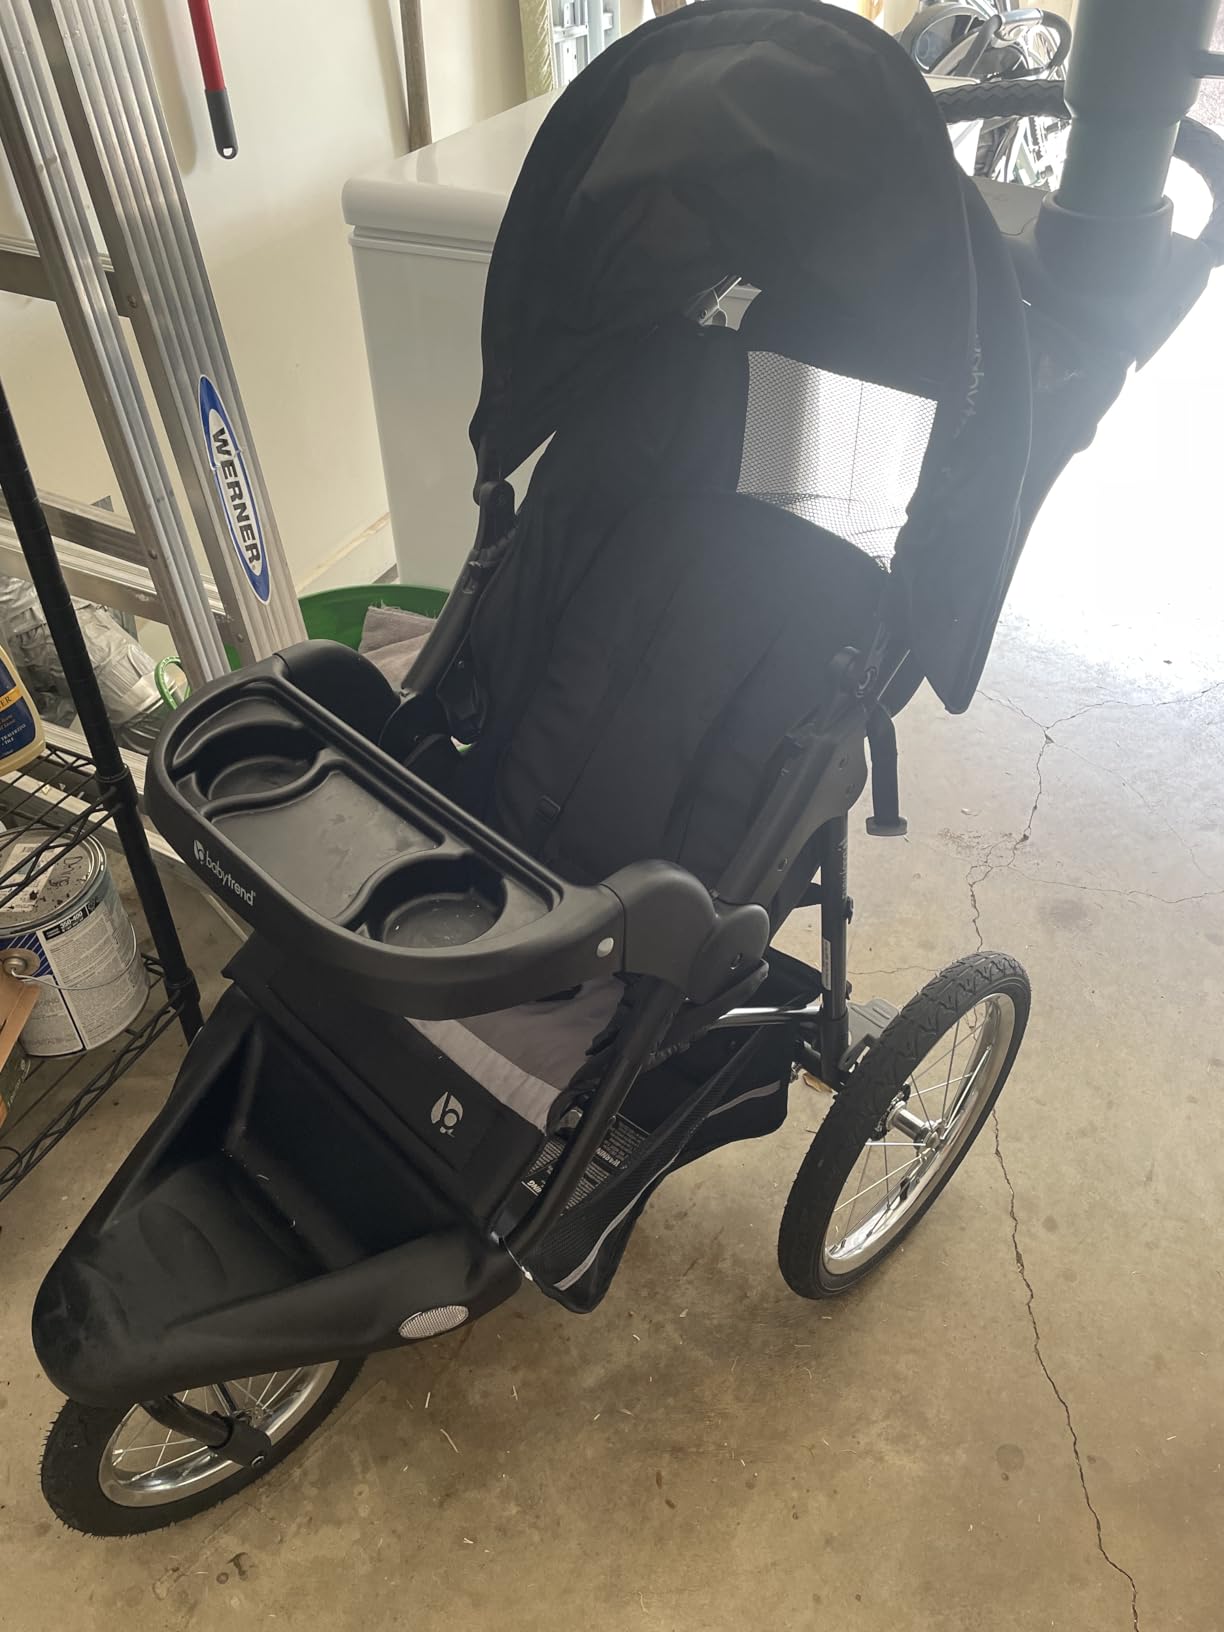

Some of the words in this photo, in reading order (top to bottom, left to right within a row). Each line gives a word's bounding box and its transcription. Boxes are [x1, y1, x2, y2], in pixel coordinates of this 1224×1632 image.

[212, 427, 261, 564] WERNER
[206, 851, 254, 906] babytrend
[596, 1148, 620, 1167] WARNIN
